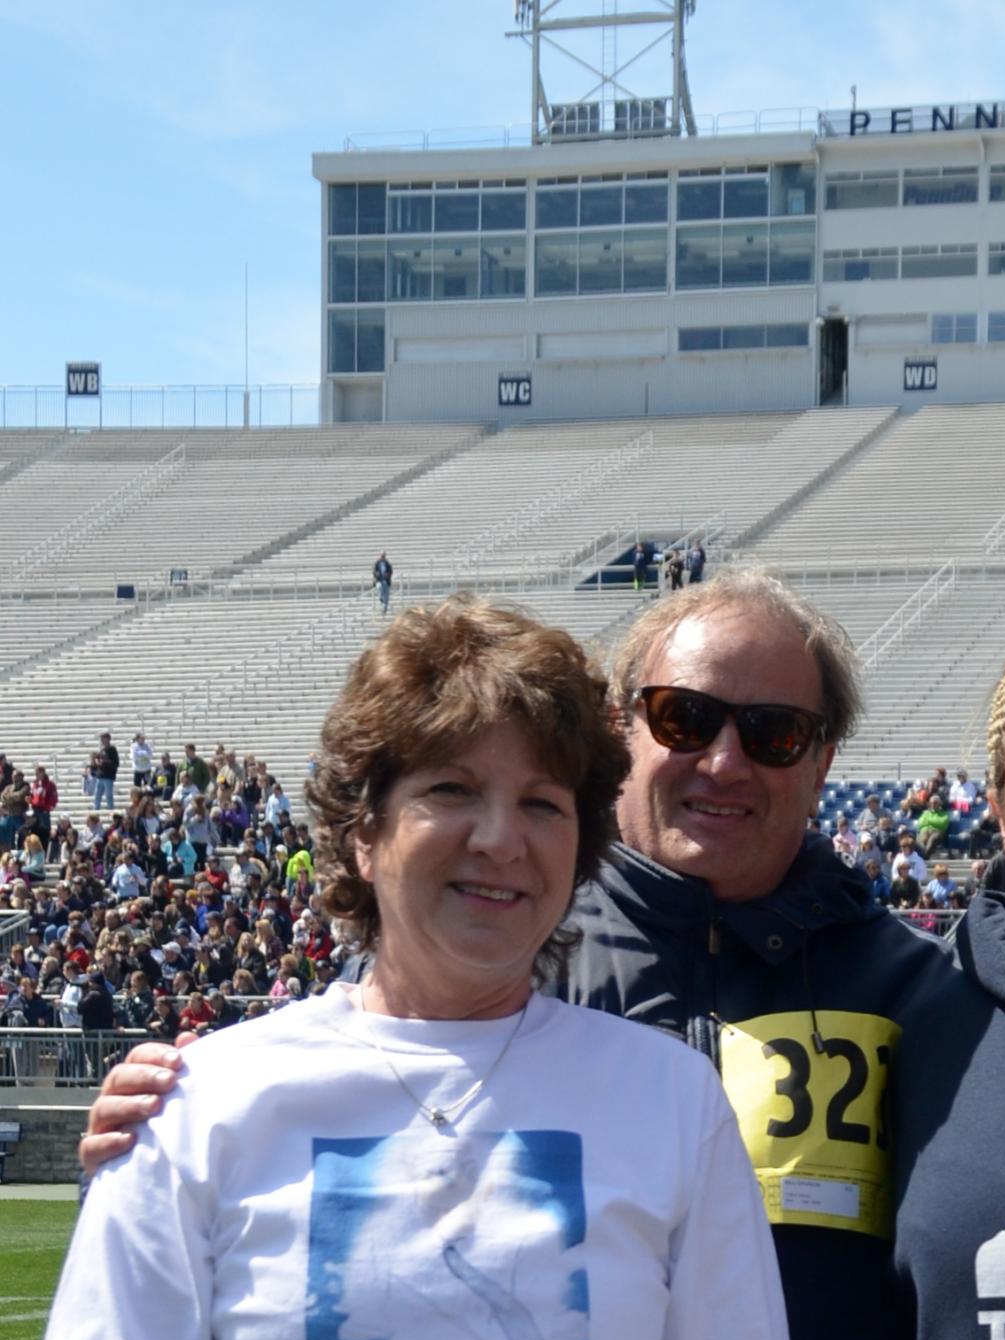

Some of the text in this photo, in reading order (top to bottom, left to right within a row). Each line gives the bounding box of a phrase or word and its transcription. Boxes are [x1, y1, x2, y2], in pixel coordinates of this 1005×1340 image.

[849, 102, 999, 136] PENN
[69, 373, 98, 393] WB
[905, 366, 936, 388] WD
[500, 381, 530, 402] WC
[762, 1037, 894, 1151] 32
